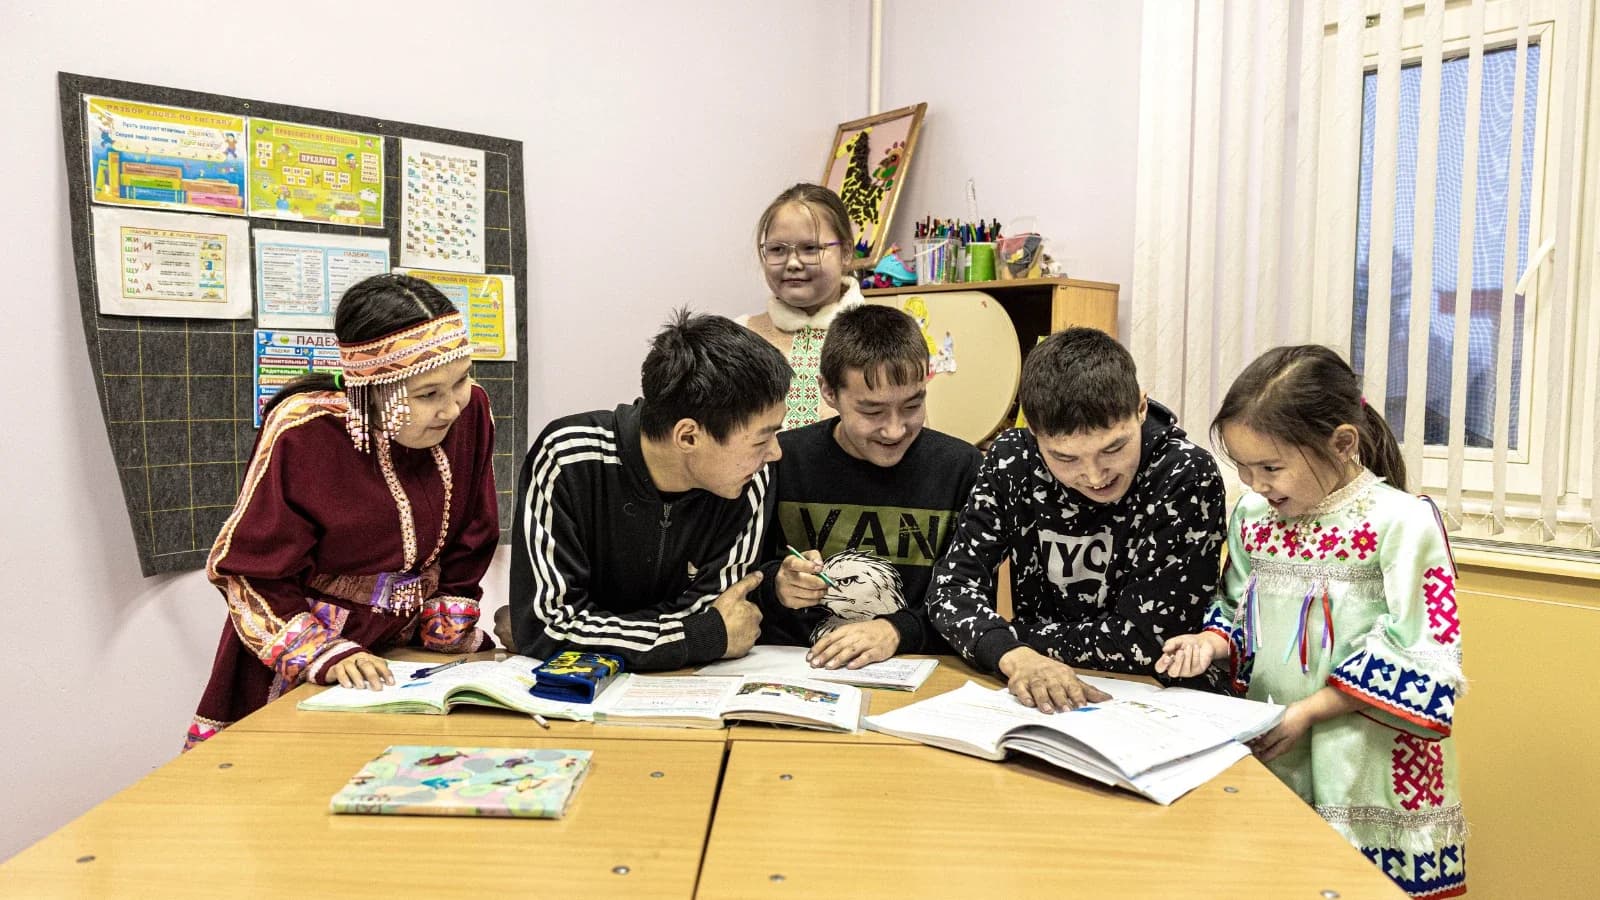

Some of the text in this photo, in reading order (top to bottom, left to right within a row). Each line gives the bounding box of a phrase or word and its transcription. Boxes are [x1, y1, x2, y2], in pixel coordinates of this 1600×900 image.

[124, 245, 139, 253] ШИ
[144, 242, 152, 251] И
[144, 263, 151, 271] У
[145, 283, 153, 291] А
